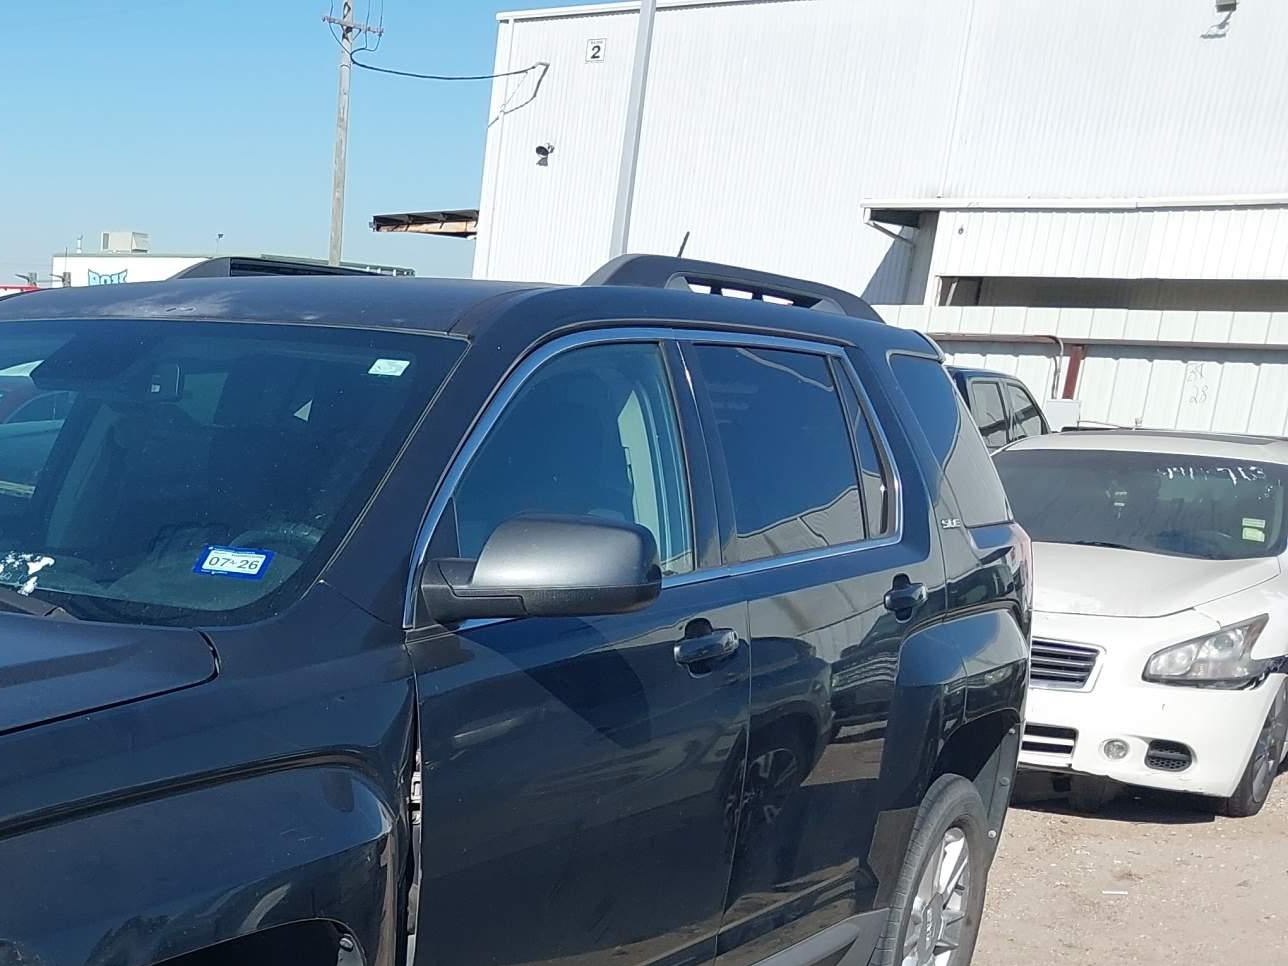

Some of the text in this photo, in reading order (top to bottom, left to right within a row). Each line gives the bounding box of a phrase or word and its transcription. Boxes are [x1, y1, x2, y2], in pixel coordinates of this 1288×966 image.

[590, 45, 601, 59] 2
[208, 556, 259, 570] 07 26
